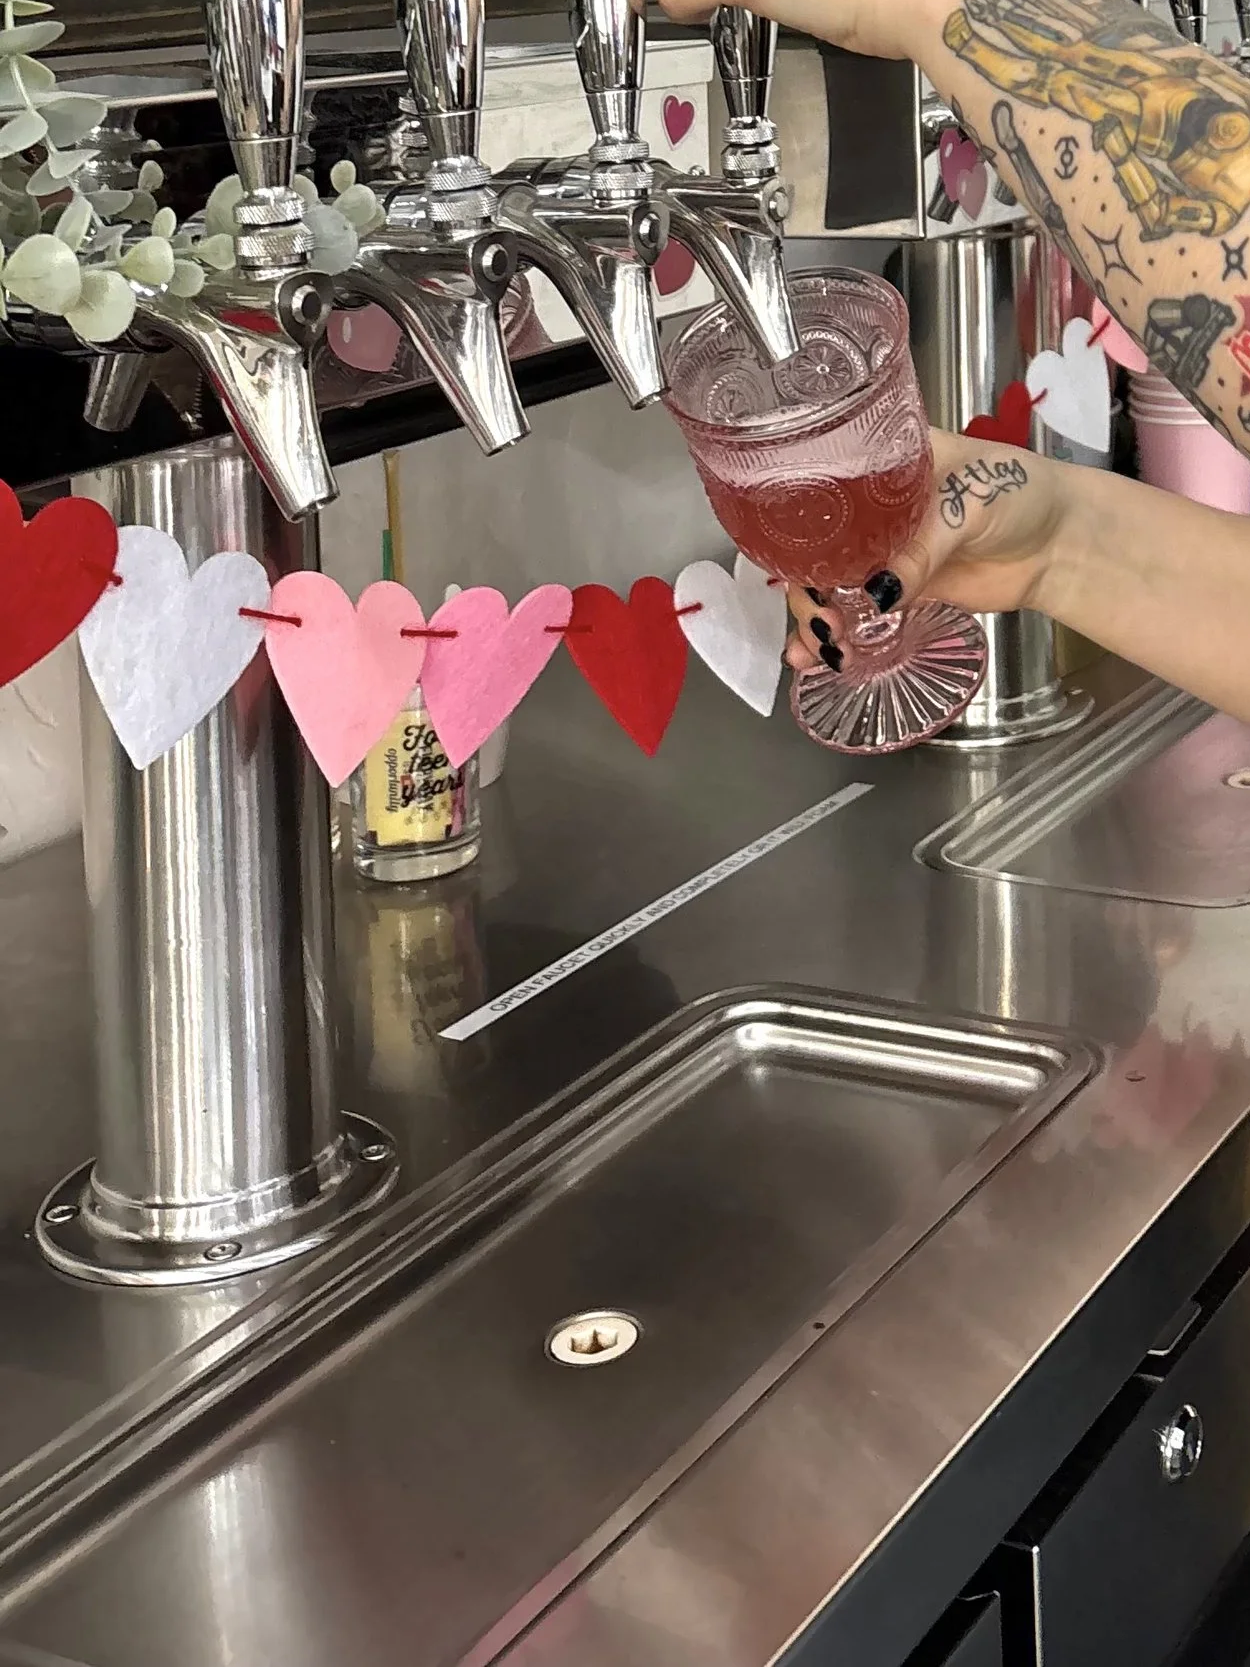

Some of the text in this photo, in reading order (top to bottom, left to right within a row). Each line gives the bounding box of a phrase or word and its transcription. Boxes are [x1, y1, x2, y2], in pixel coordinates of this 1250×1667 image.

[490, 986, 536, 1012] OPEN
[532, 952, 590, 986] FAUCET
[589, 917, 647, 951] QUICKLY
[646, 899, 676, 917] AND
